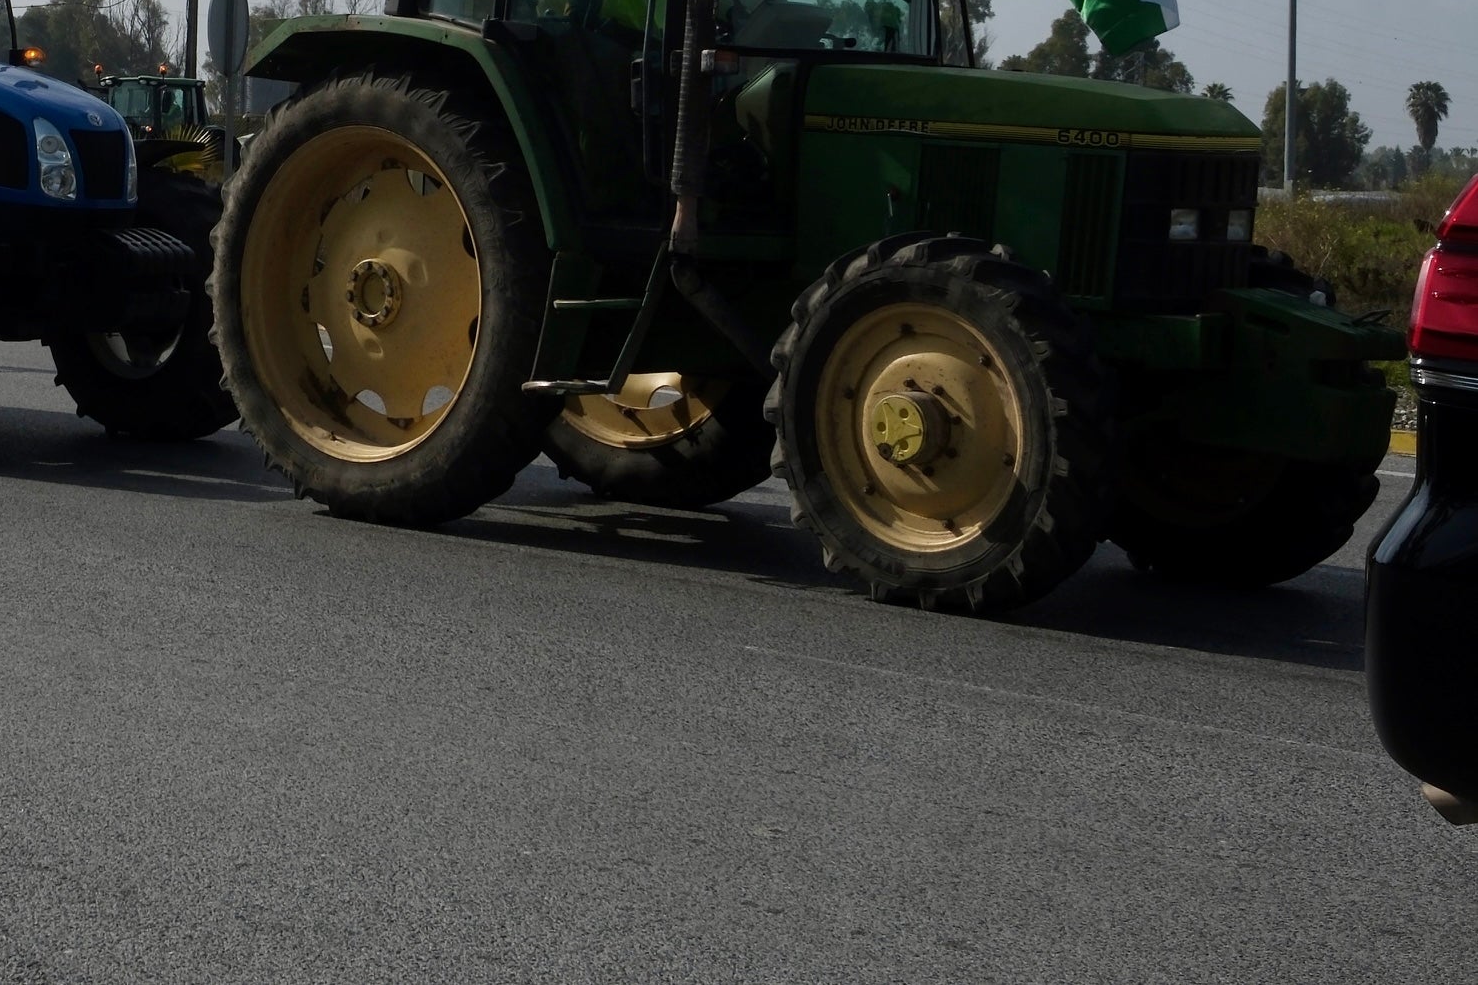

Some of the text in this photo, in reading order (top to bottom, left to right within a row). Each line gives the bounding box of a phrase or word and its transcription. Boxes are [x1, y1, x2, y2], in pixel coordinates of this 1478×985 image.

[826, 117, 930, 133] JOHN DEERE
[1057, 130, 1120, 147] 6400
